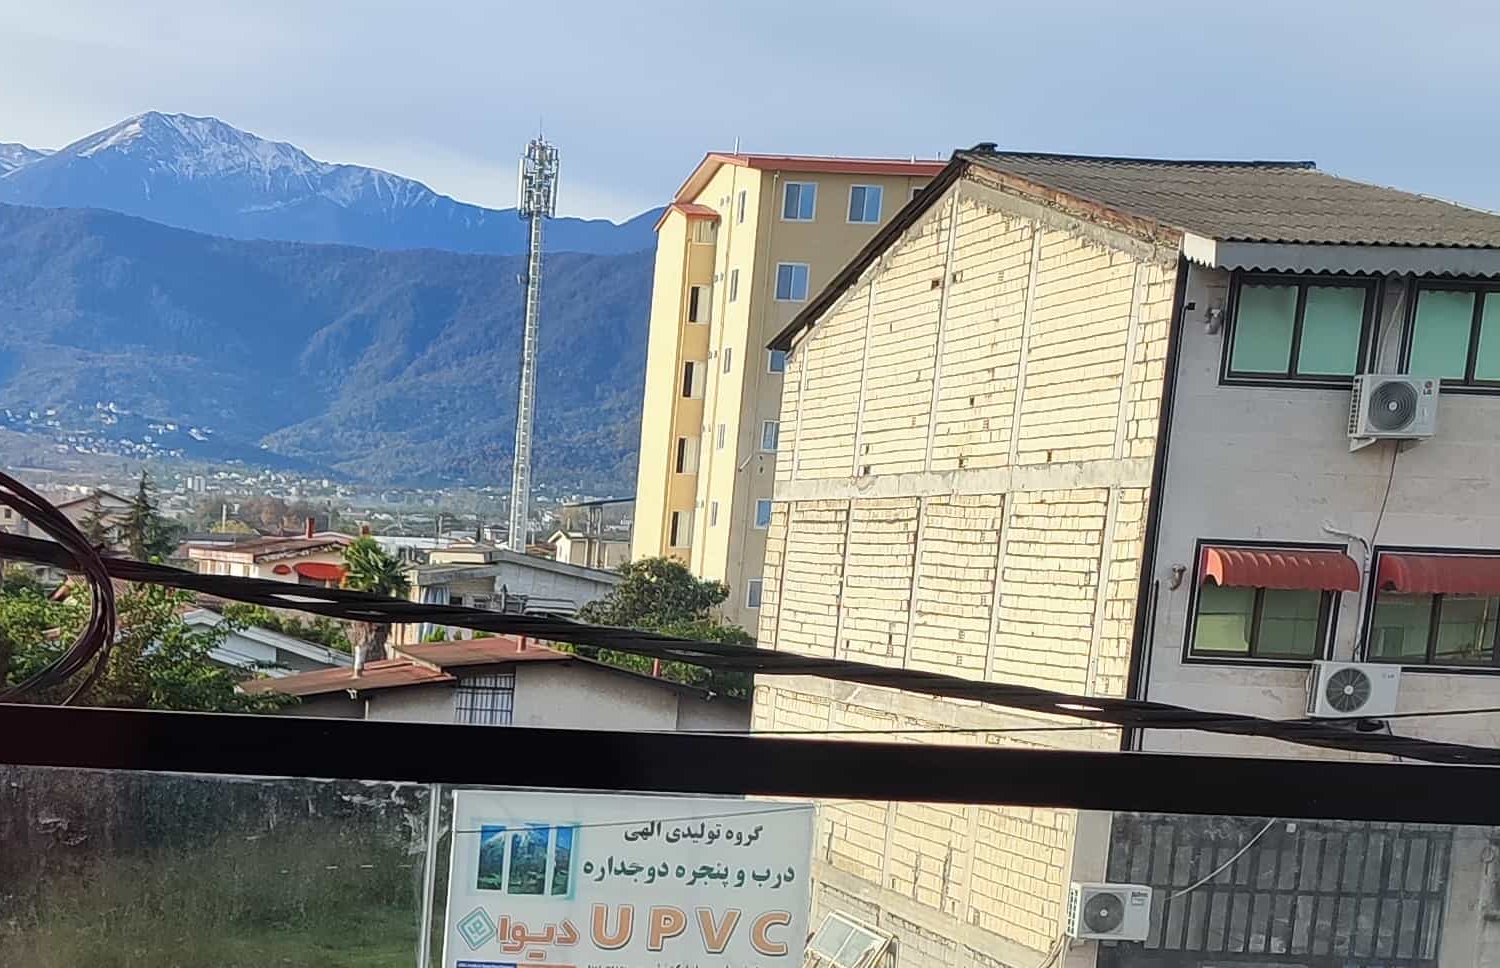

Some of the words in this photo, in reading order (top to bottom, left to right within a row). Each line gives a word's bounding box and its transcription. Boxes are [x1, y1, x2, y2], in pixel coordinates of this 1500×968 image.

[623, 820, 662, 842] الهی
[665, 822, 722, 845] تولیدی
[725, 825, 764, 847] گروه
[675, 862, 730, 889] پنجره
[733, 870, 747, 888] و
[751, 866, 796, 889] درب
[497, 912, 581, 961] دیوا
[588, 902, 793, 957] UPVC
